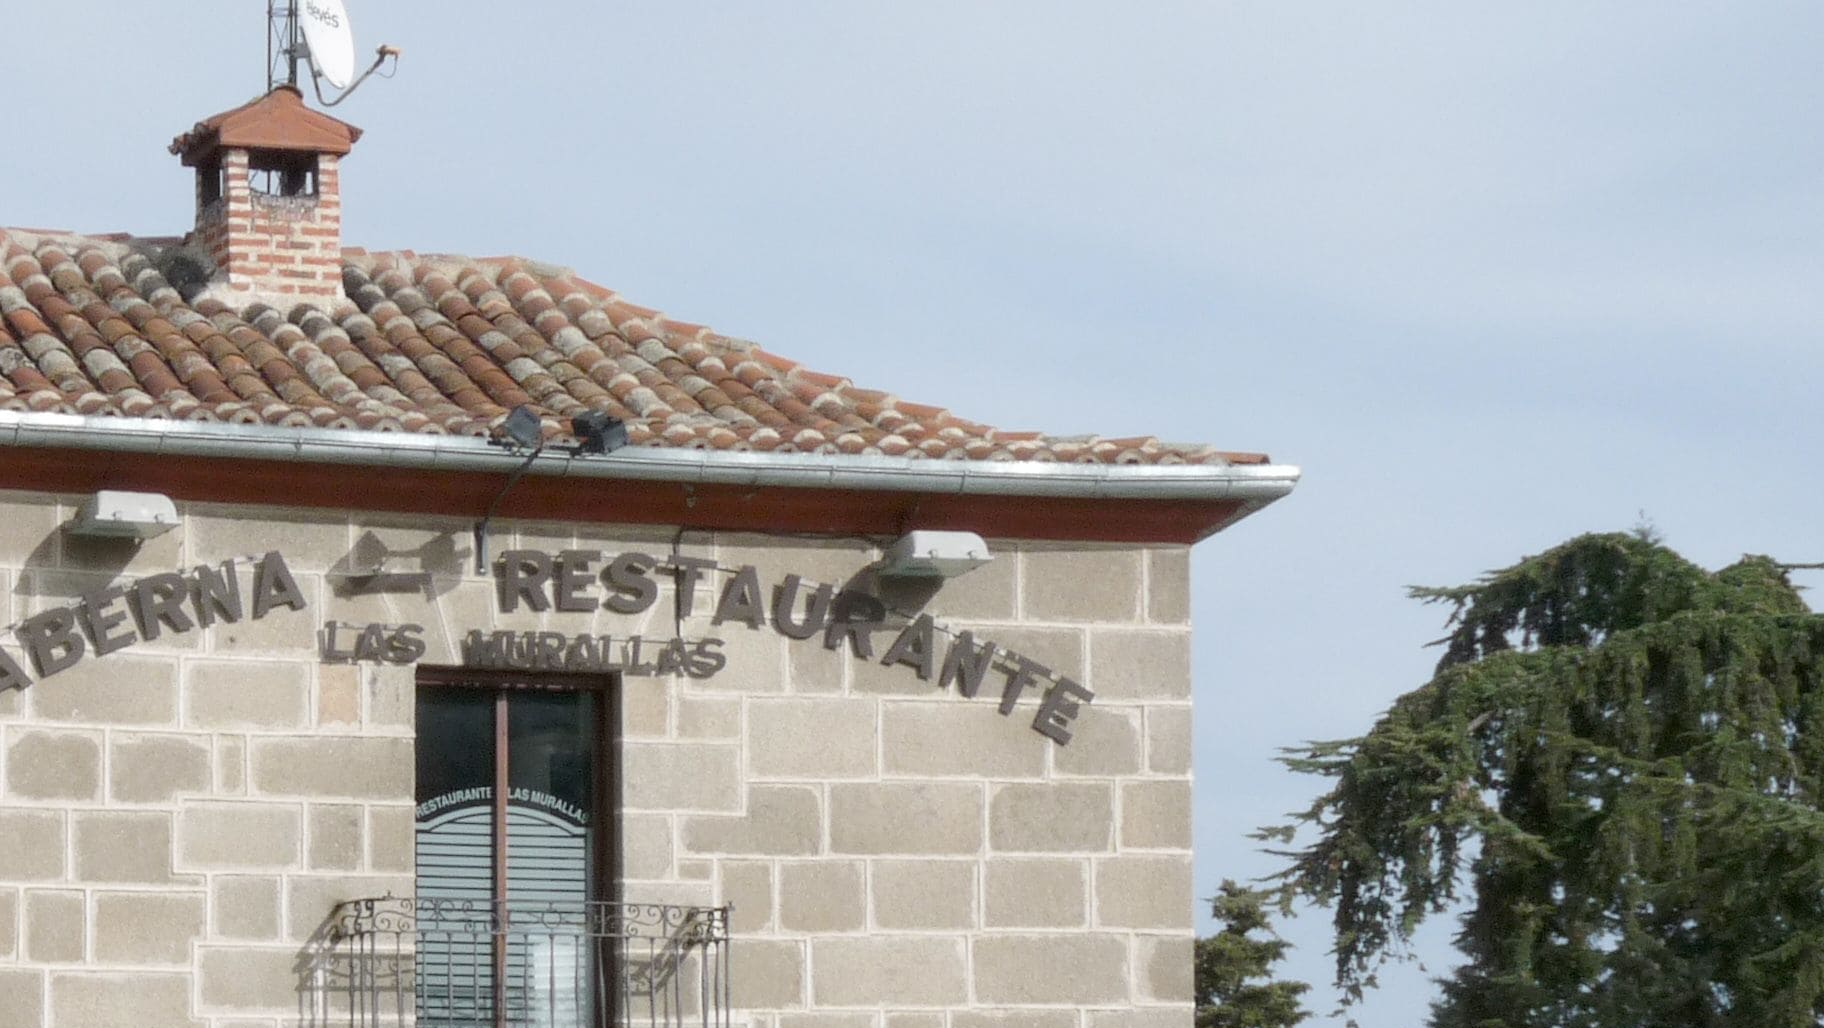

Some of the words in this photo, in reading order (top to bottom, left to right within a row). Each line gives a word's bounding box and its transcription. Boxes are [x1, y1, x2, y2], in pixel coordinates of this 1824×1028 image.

[323, 620, 427, 664] LAS
[464, 628, 727, 680] MURALLAS
[496, 548, 1094, 746] RESTAURANTE
[416, 786, 492, 818] RESTAURANTE
[508, 787, 529, 801] LAS
[531, 790, 589, 824] MURALLAS
